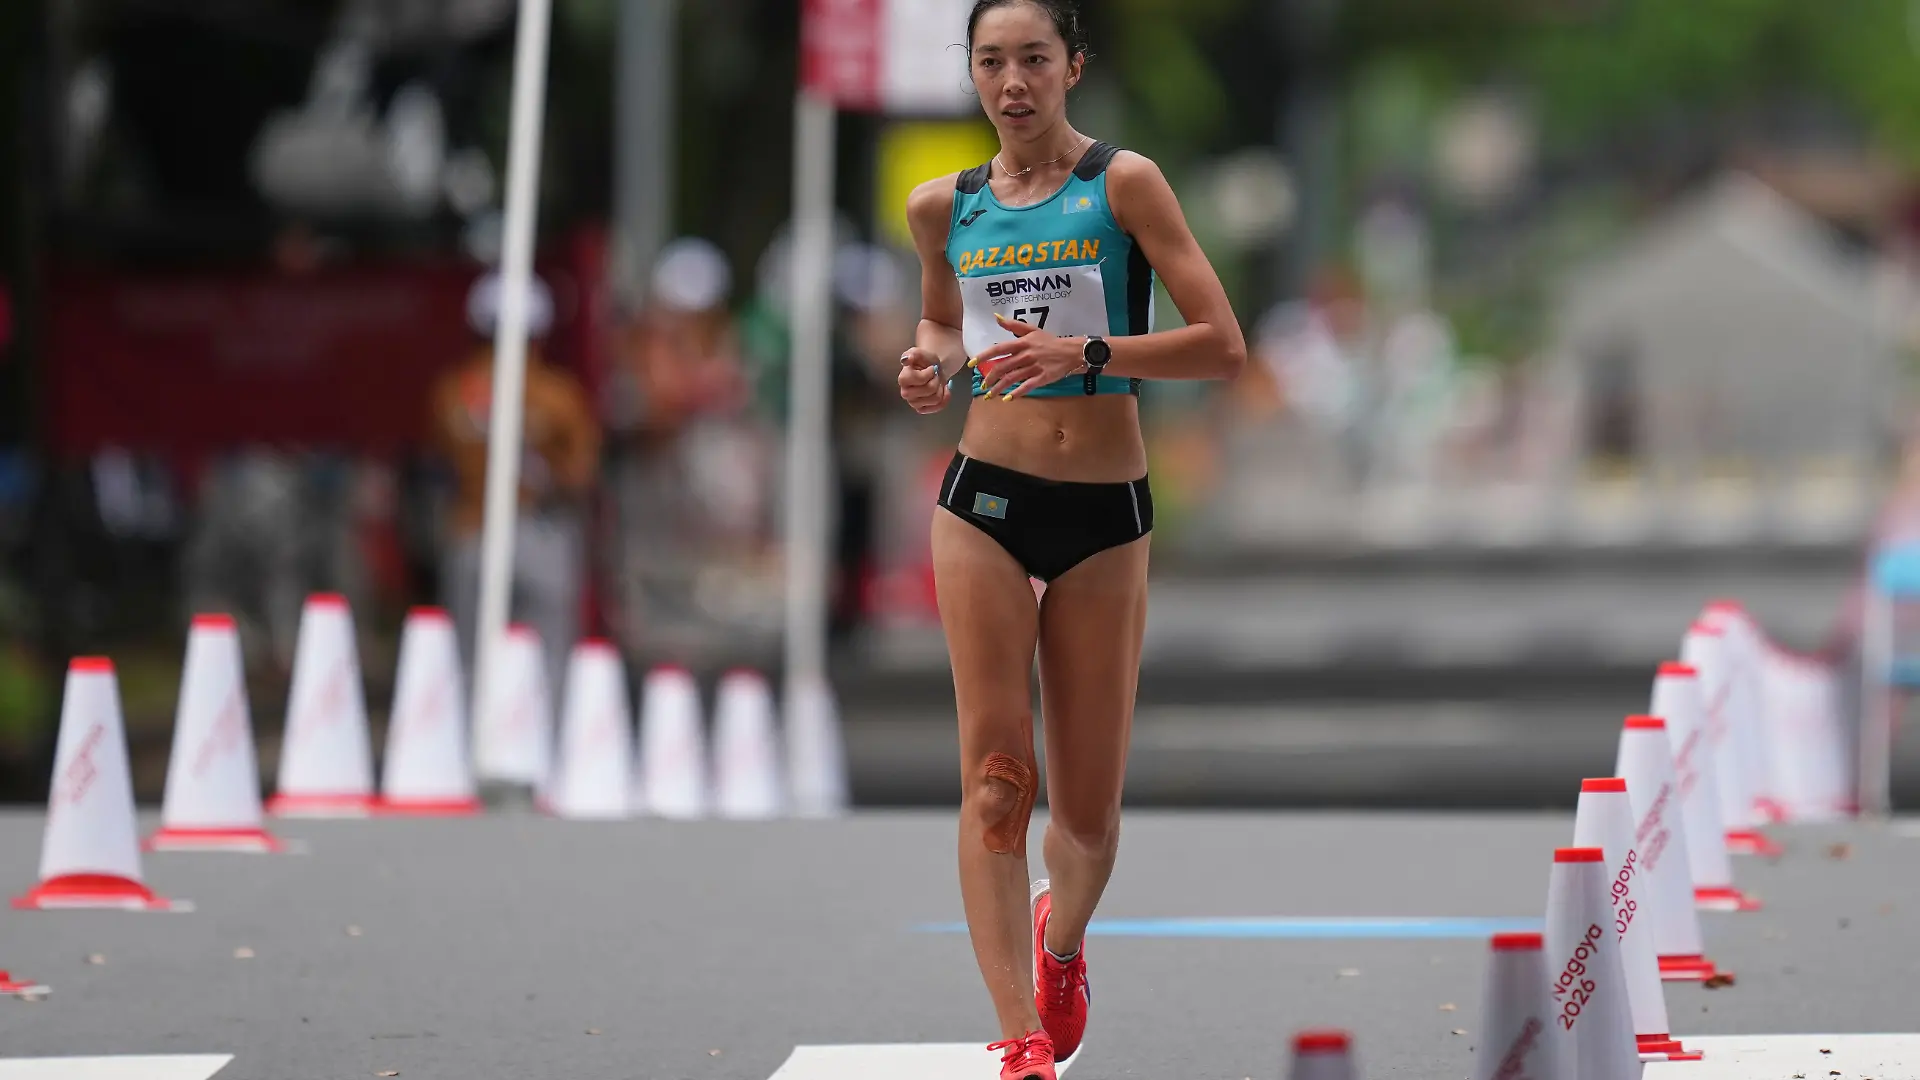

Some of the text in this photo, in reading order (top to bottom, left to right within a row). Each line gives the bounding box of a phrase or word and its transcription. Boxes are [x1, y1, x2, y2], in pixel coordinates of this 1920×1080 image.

[959, 239, 1100, 275] QAZAQSTAN
[985, 273, 1072, 297] BORNAN
[991, 290, 1072, 306] SPORTS TECHNOLOGY
[1611, 849, 1637, 905] agoya
[1616, 899, 1637, 943] 026
[1553, 923, 1603, 1002] Nagoya
[1557, 978, 1596, 1031] 2026
